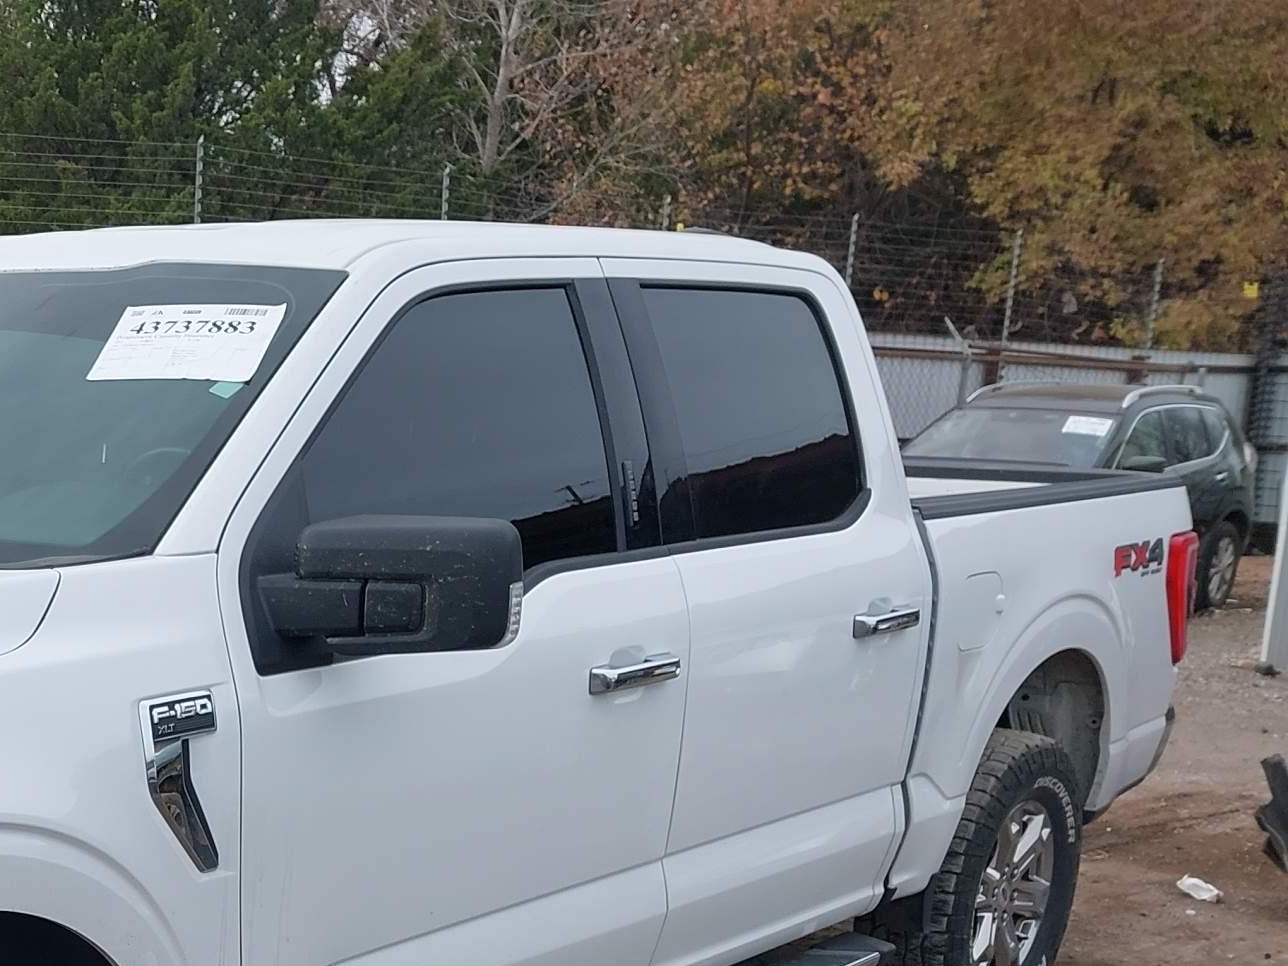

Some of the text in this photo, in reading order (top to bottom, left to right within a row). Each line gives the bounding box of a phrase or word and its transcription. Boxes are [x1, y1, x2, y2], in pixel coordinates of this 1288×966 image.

[130, 320, 256, 334] 43737883
[1114, 537, 1164, 577] FX4
[152, 698, 212, 724] F-150
[157, 723, 175, 735] XLT
